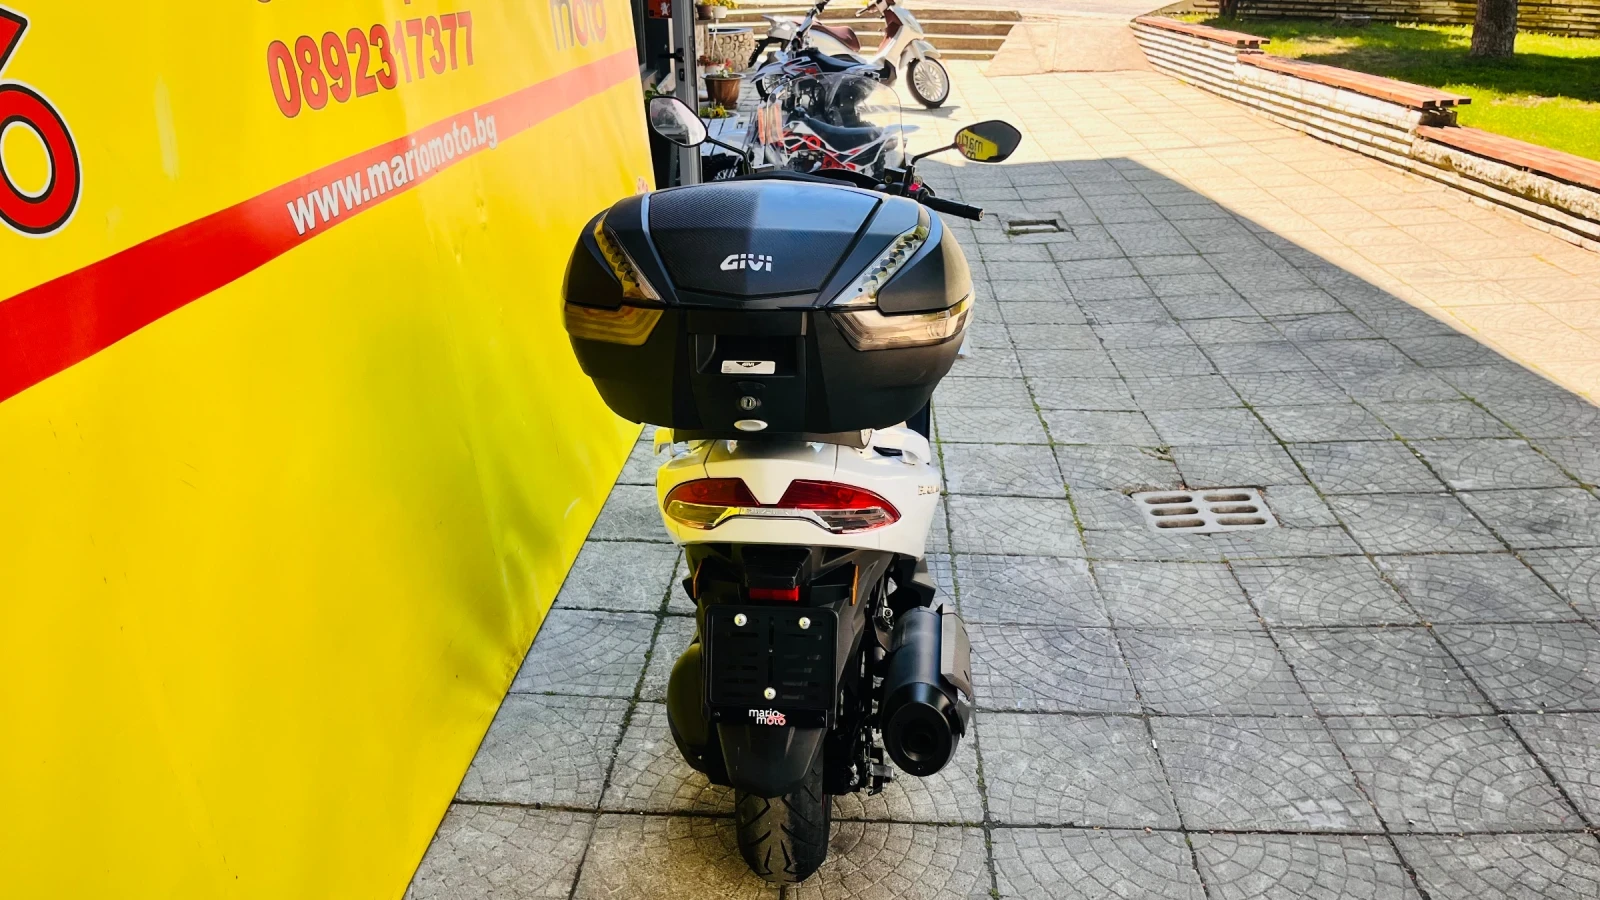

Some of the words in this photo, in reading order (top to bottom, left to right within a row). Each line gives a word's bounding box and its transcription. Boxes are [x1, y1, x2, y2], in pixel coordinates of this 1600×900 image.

[267, 11, 473, 118] 0892317377
[287, 112, 497, 236] www.mariomoto.bg
[720, 253, 772, 272] GIVI
[748, 708, 779, 717] mario
[756, 716, 786, 726] moto
